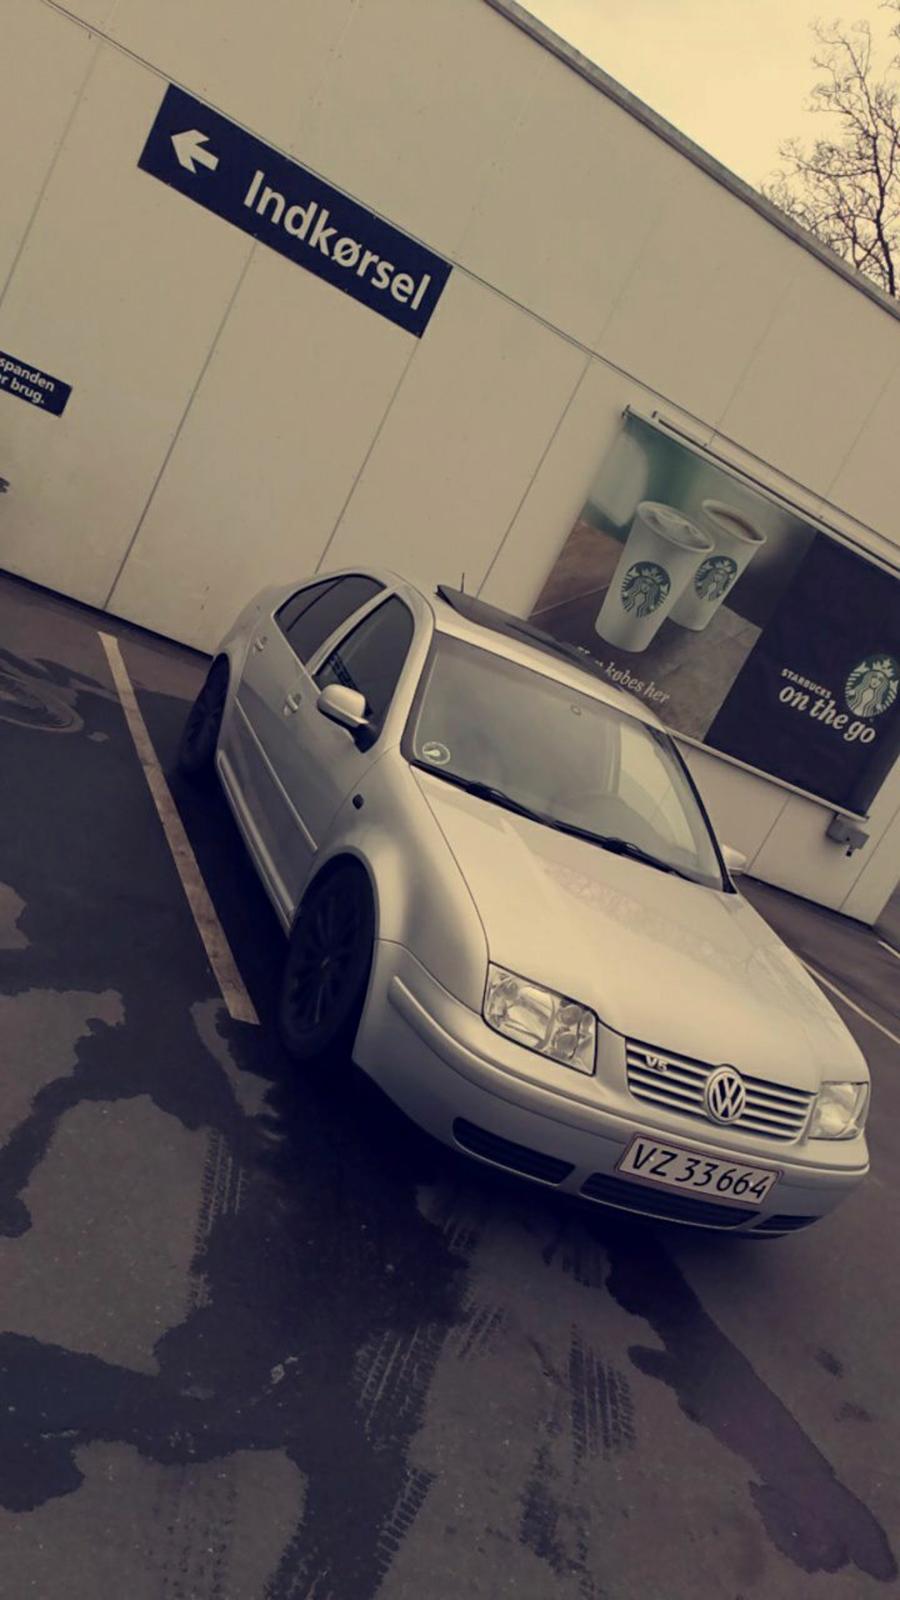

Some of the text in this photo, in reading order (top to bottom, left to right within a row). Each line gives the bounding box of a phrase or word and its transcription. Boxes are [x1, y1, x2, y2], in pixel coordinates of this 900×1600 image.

[243, 169, 431, 311] Indkørsel
[10, 377, 45, 404] brug.
[643, 681, 671, 703] her
[781, 668, 832, 699] STARBUCKS
[779, 686, 876, 743] on the go
[632, 1143, 678, 1177] VZ
